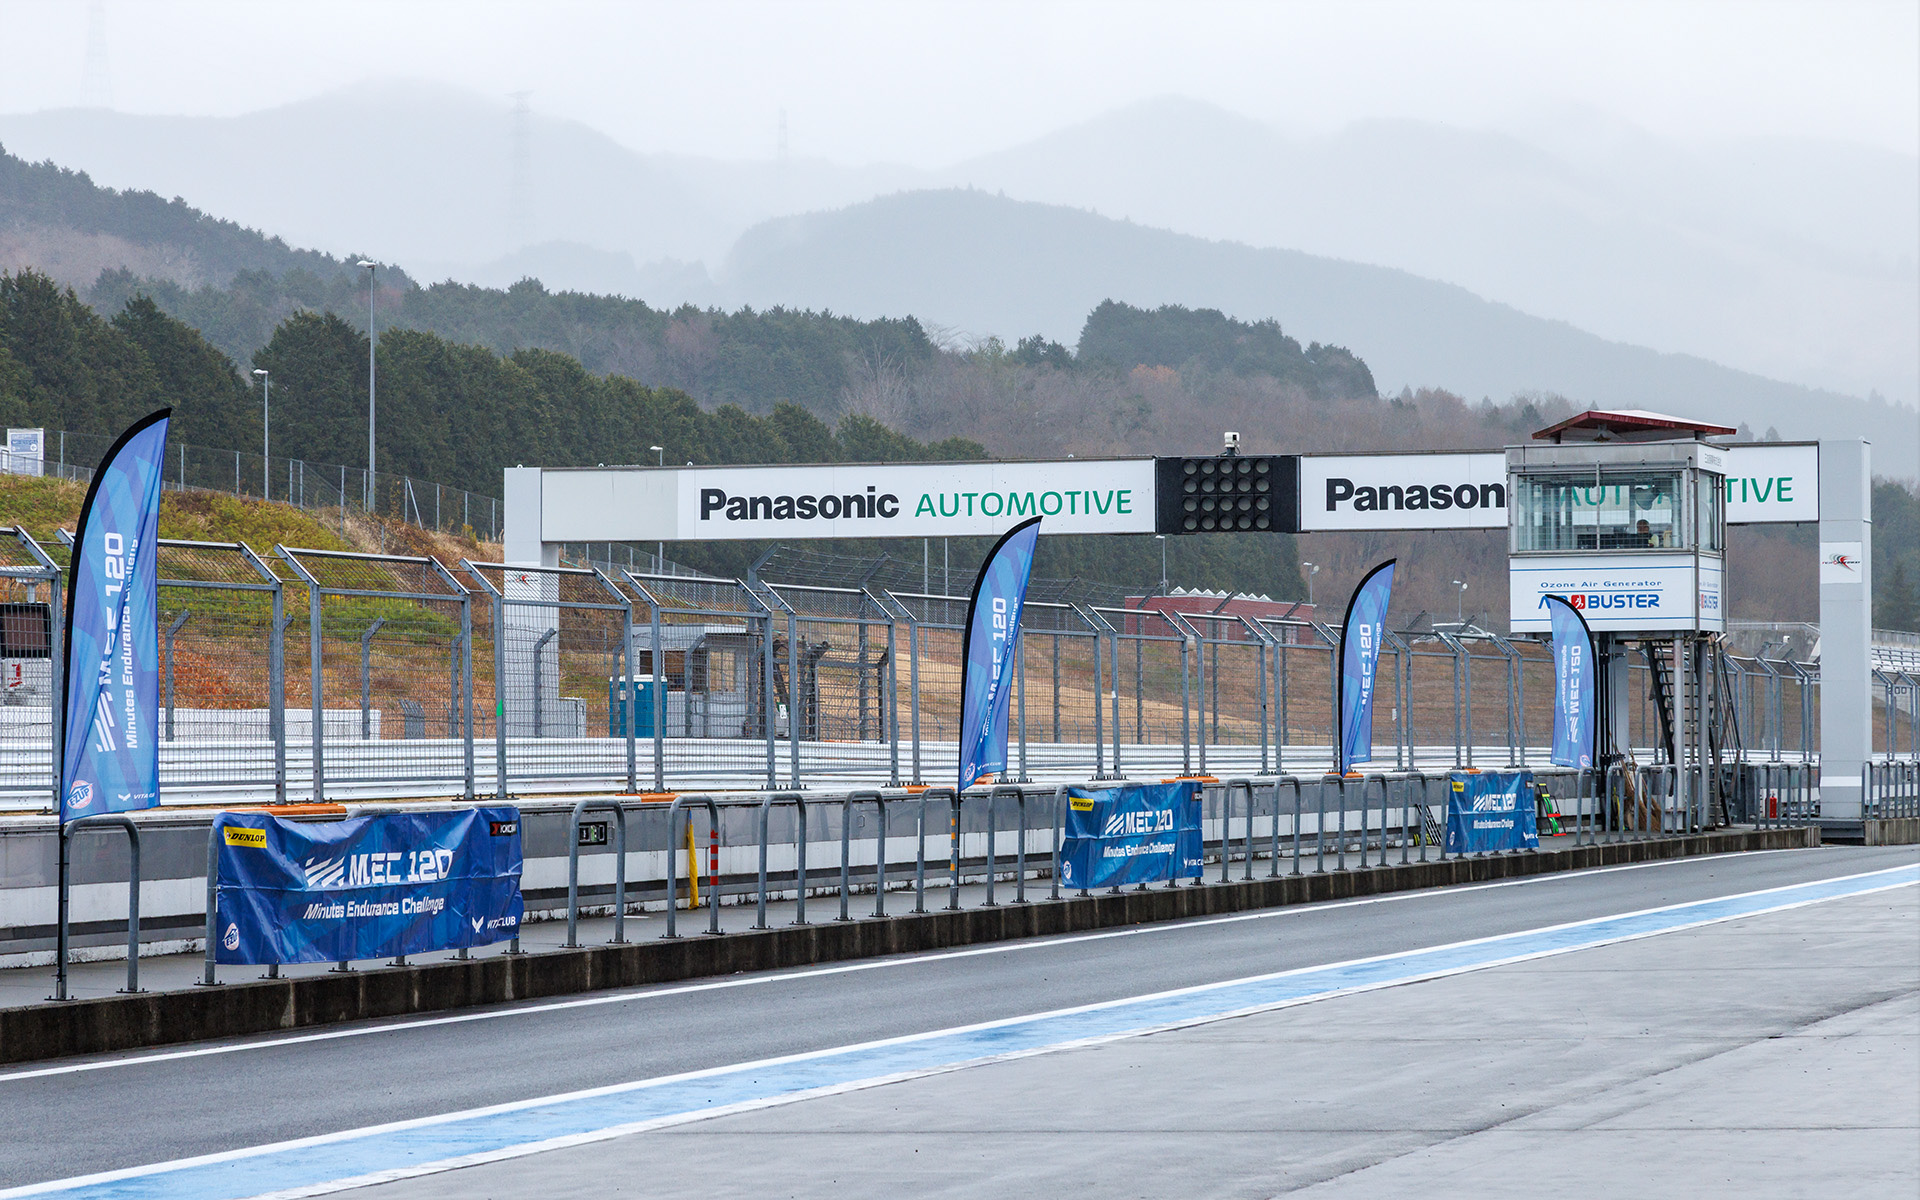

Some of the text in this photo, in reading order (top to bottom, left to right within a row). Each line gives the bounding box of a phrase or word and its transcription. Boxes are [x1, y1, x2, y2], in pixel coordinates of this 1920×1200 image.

[700, 486, 1132, 520] Panasonic AUTOMOTIVE
[1326, 475, 1508, 511] Panason
[104, 532, 125, 597] 120
[1588, 594, 1660, 608] BUSTER
[993, 597, 1007, 642] 120
[122, 606, 134, 686] Endurance
[1360, 623, 1371, 658] 120
[125, 689, 138, 749] Minutes
[231, 832, 265, 842] DUNLOP
[1126, 811, 1153, 834] MEC
[350, 849, 453, 886] MEC 120
[303, 902, 345, 920] Minutes
[346, 900, 399, 917] Endurance
